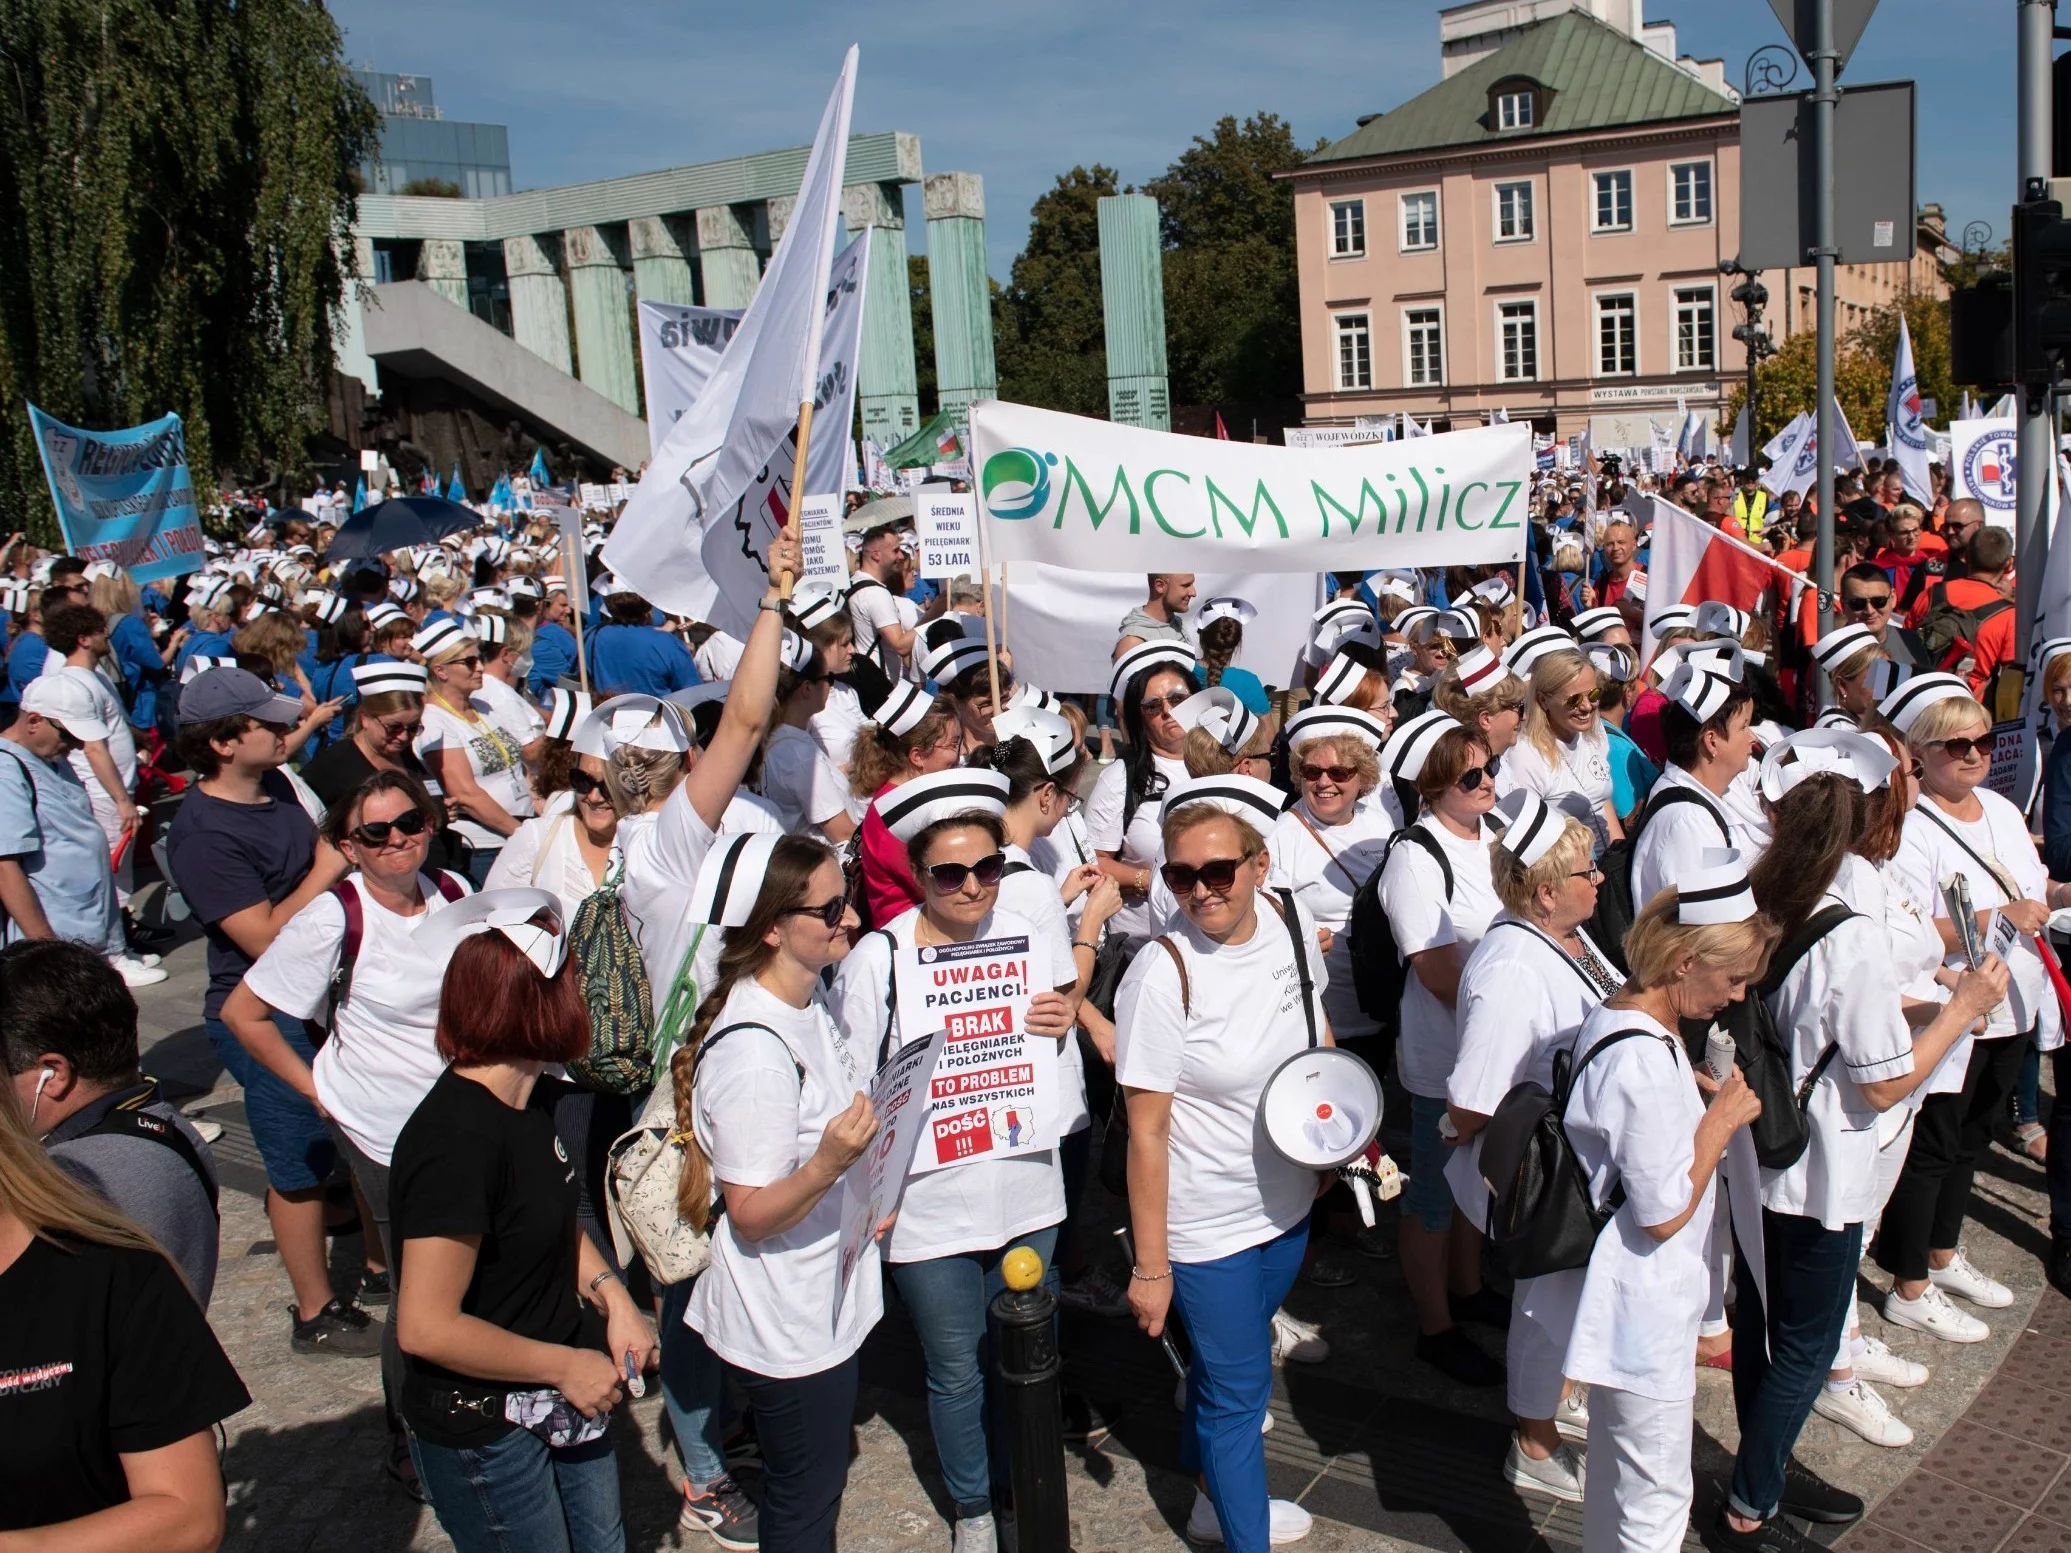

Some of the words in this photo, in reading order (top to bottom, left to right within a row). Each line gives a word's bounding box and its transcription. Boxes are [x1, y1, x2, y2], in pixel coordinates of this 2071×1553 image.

[1594, 388, 1638, 398] WYSTAWA
[1315, 430, 1385, 442] WOJEWÓDZKI
[1053, 455, 1290, 539] MCM
[1310, 466, 1523, 538] Milicz
[931, 504, 965, 516] ŚREDNIA
[936, 521, 961, 531] WIEKU
[803, 544, 826, 555] OMÓC
[928, 553, 942, 566] 53
[945, 553, 971, 566] LATA
[806, 556, 824, 566] JAKO
[951, 1011, 1006, 1038] BRAK
[943, 1033, 1026, 1056] IELĘGNIAREK
[939, 1060, 943, 1070] I
[947, 1047, 1023, 1068] POŁOŻNYCH
[935, 1078, 956, 1096] TO
[960, 1066, 1031, 1092] PROBLEM
[931, 1098, 956, 1112] NAS
[959, 1086, 1035, 1106] WSZYSTKICH
[936, 1109, 987, 1139] DOŚĆ
[956, 1135, 974, 1157] !!!
[22, 1362, 74, 1384] medyczny
